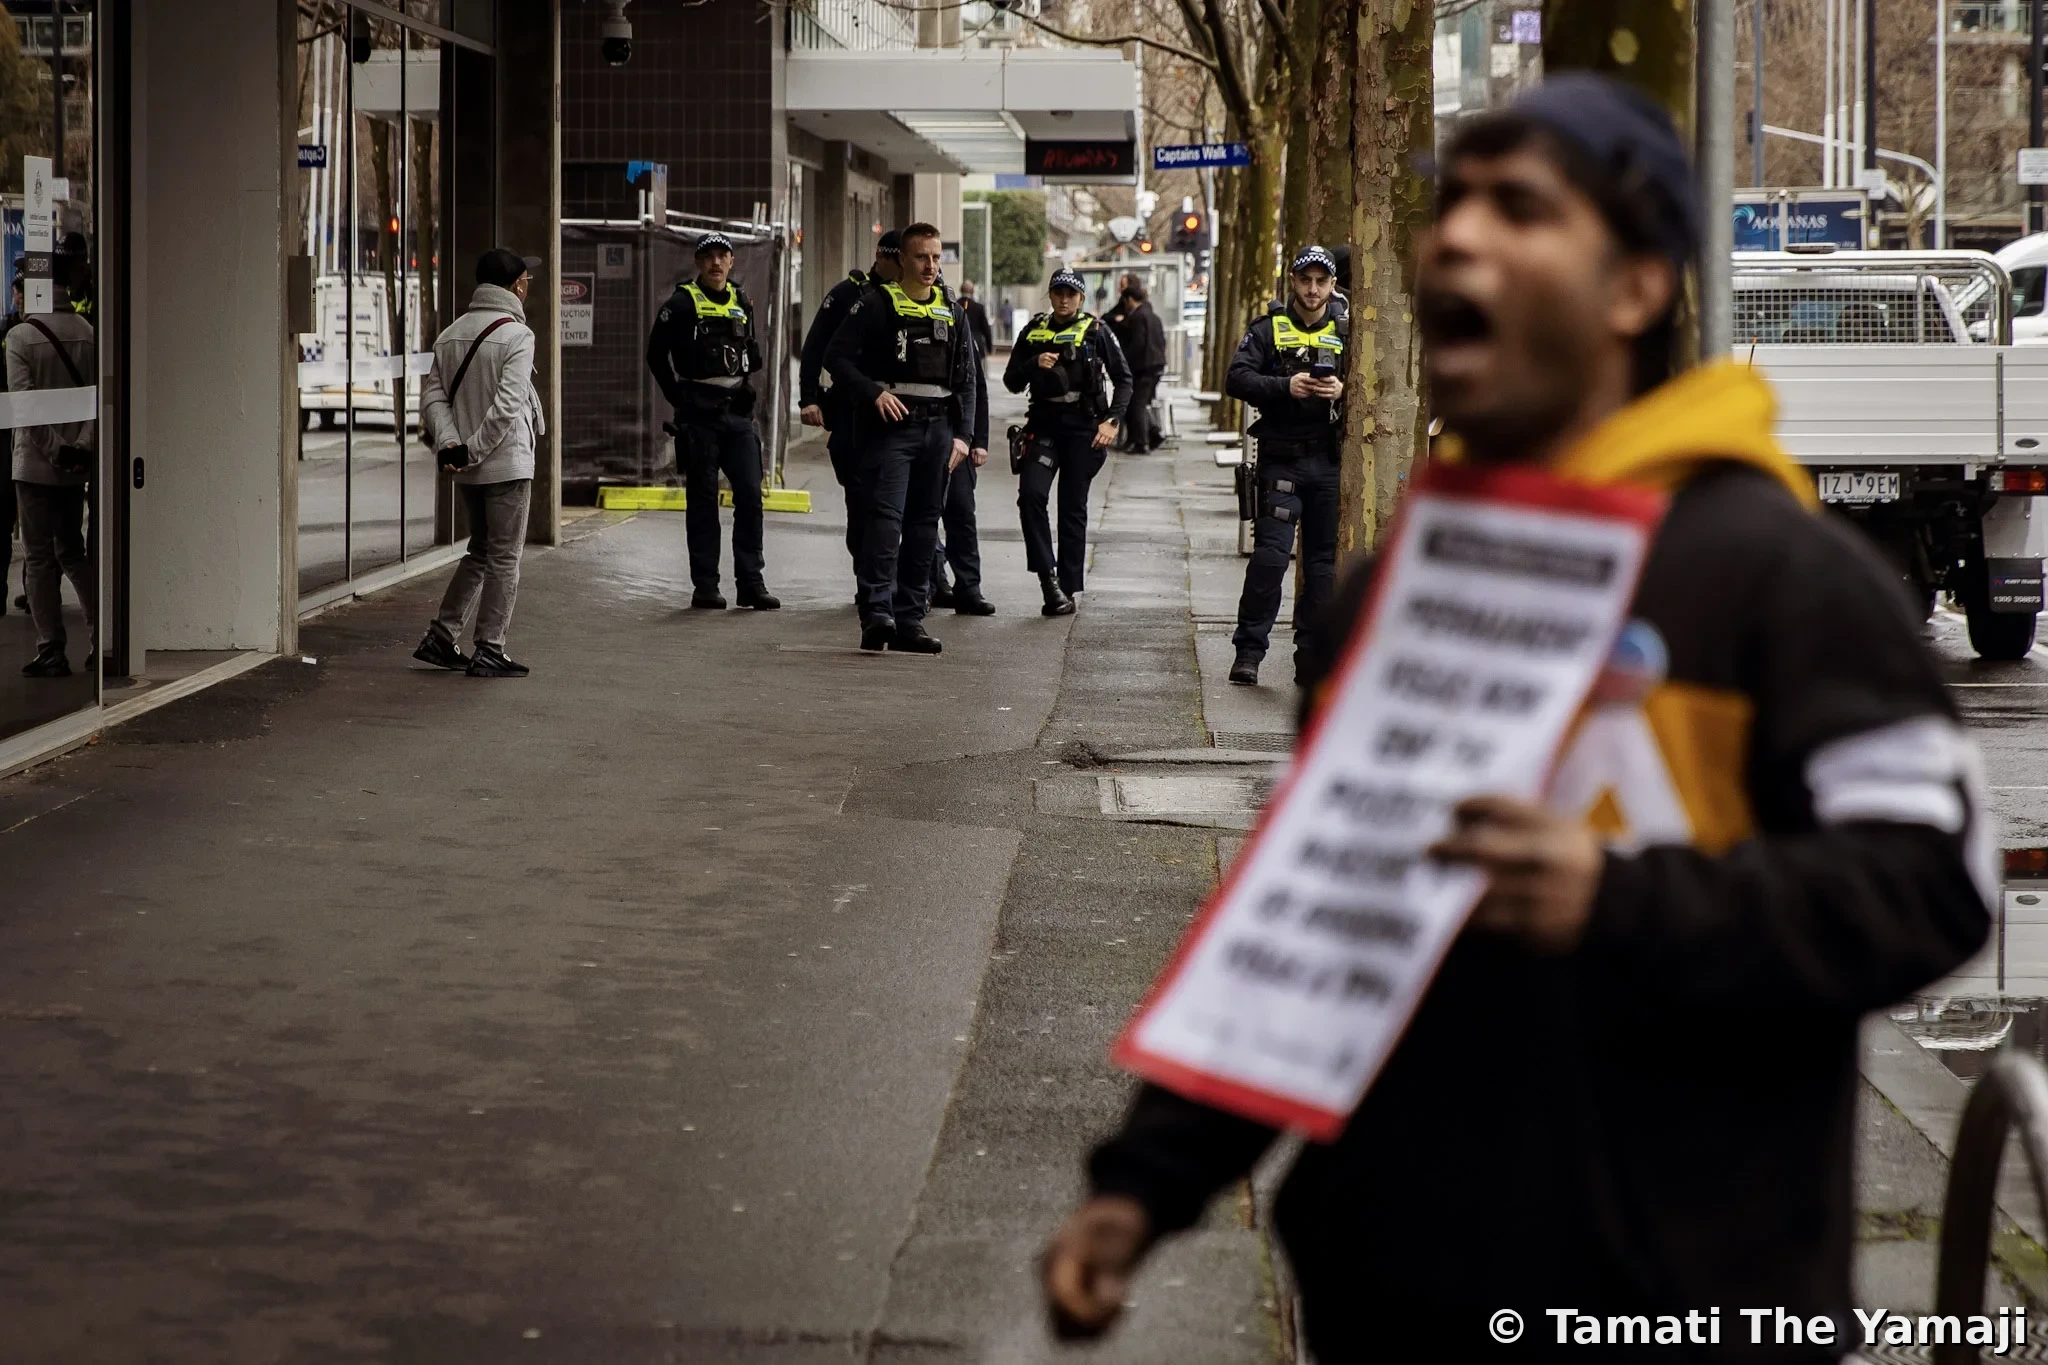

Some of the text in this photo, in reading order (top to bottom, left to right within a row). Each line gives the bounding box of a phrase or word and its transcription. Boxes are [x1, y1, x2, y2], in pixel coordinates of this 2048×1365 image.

[1157, 145, 1227, 164] Captains Walk
[565, 331, 588, 340] ENTER
[1823, 476, 1898, 494] 1ZJ 9EM
